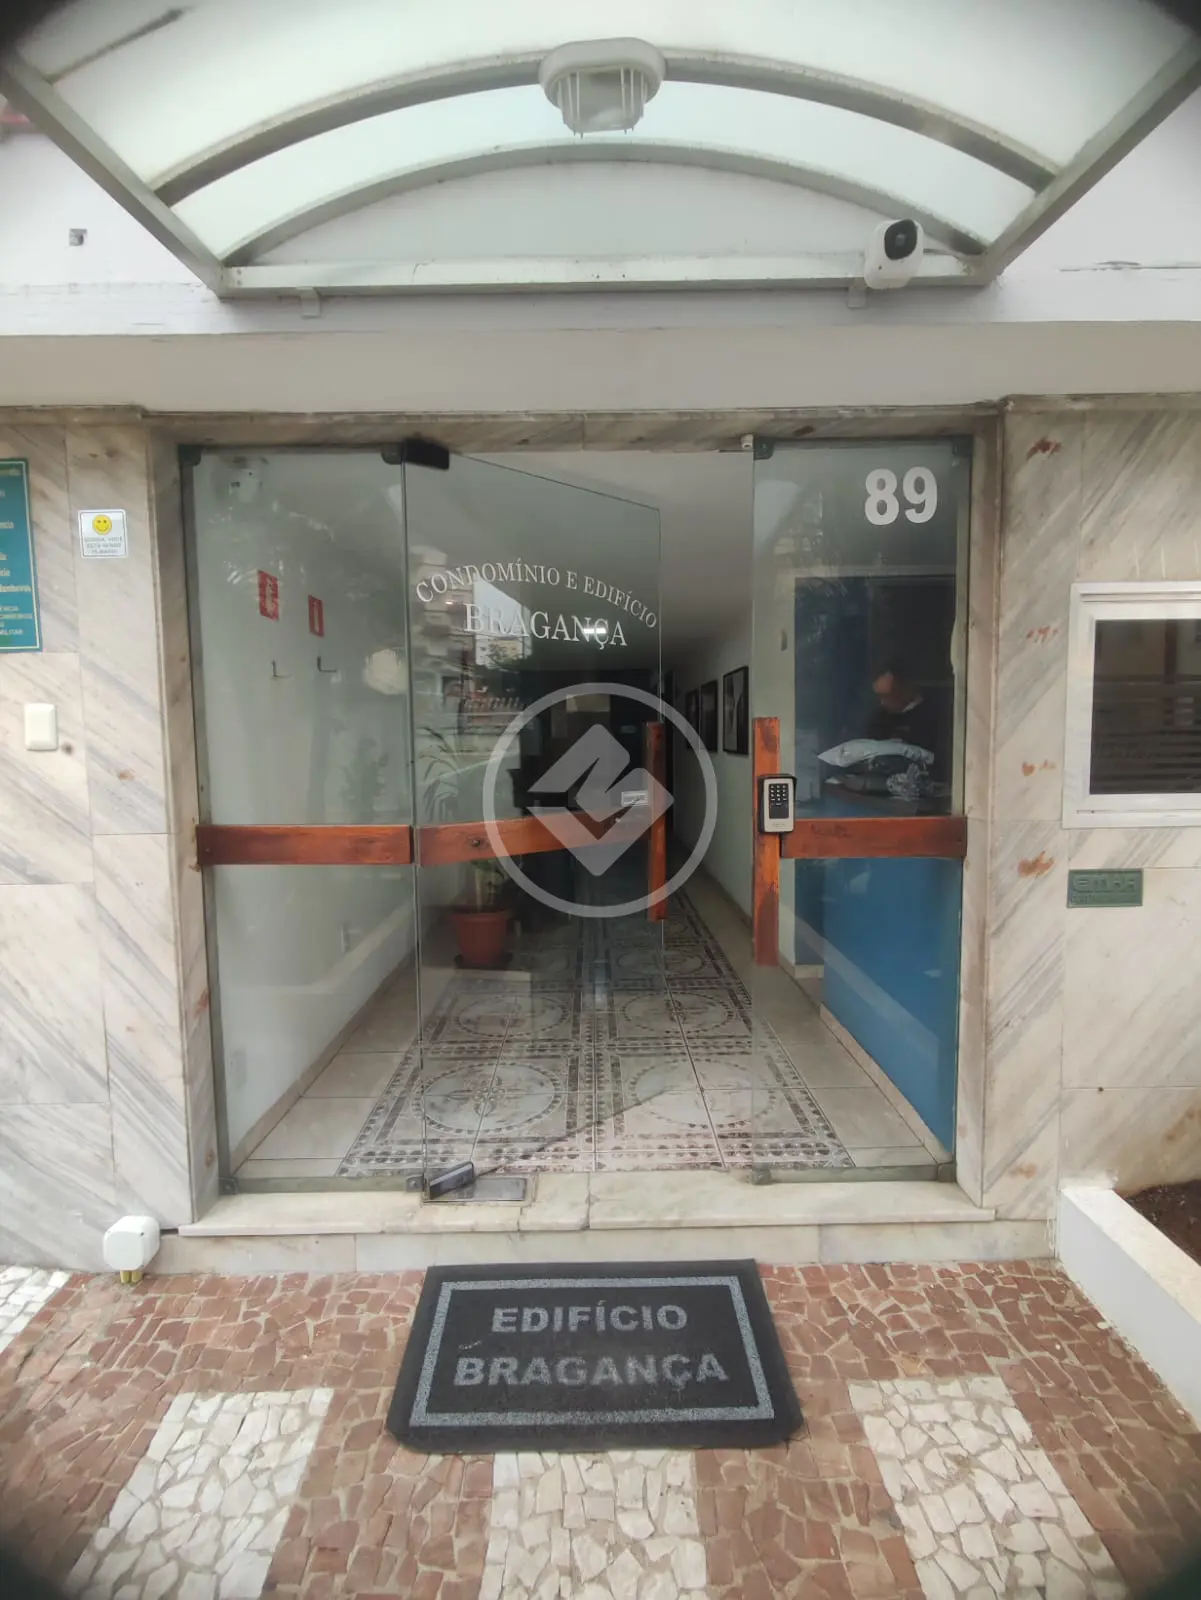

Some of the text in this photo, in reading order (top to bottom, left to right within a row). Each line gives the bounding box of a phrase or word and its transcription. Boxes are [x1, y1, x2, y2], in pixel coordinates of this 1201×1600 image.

[865, 466, 938, 526] 89
[416, 558, 657, 629] CONDOMÍNIO E EDIFÍCIO
[464, 602, 628, 650] BRAGANÇA
[491, 1301, 688, 1334] EDIFÍCIO
[453, 1352, 730, 1391] BRAGANÇA
